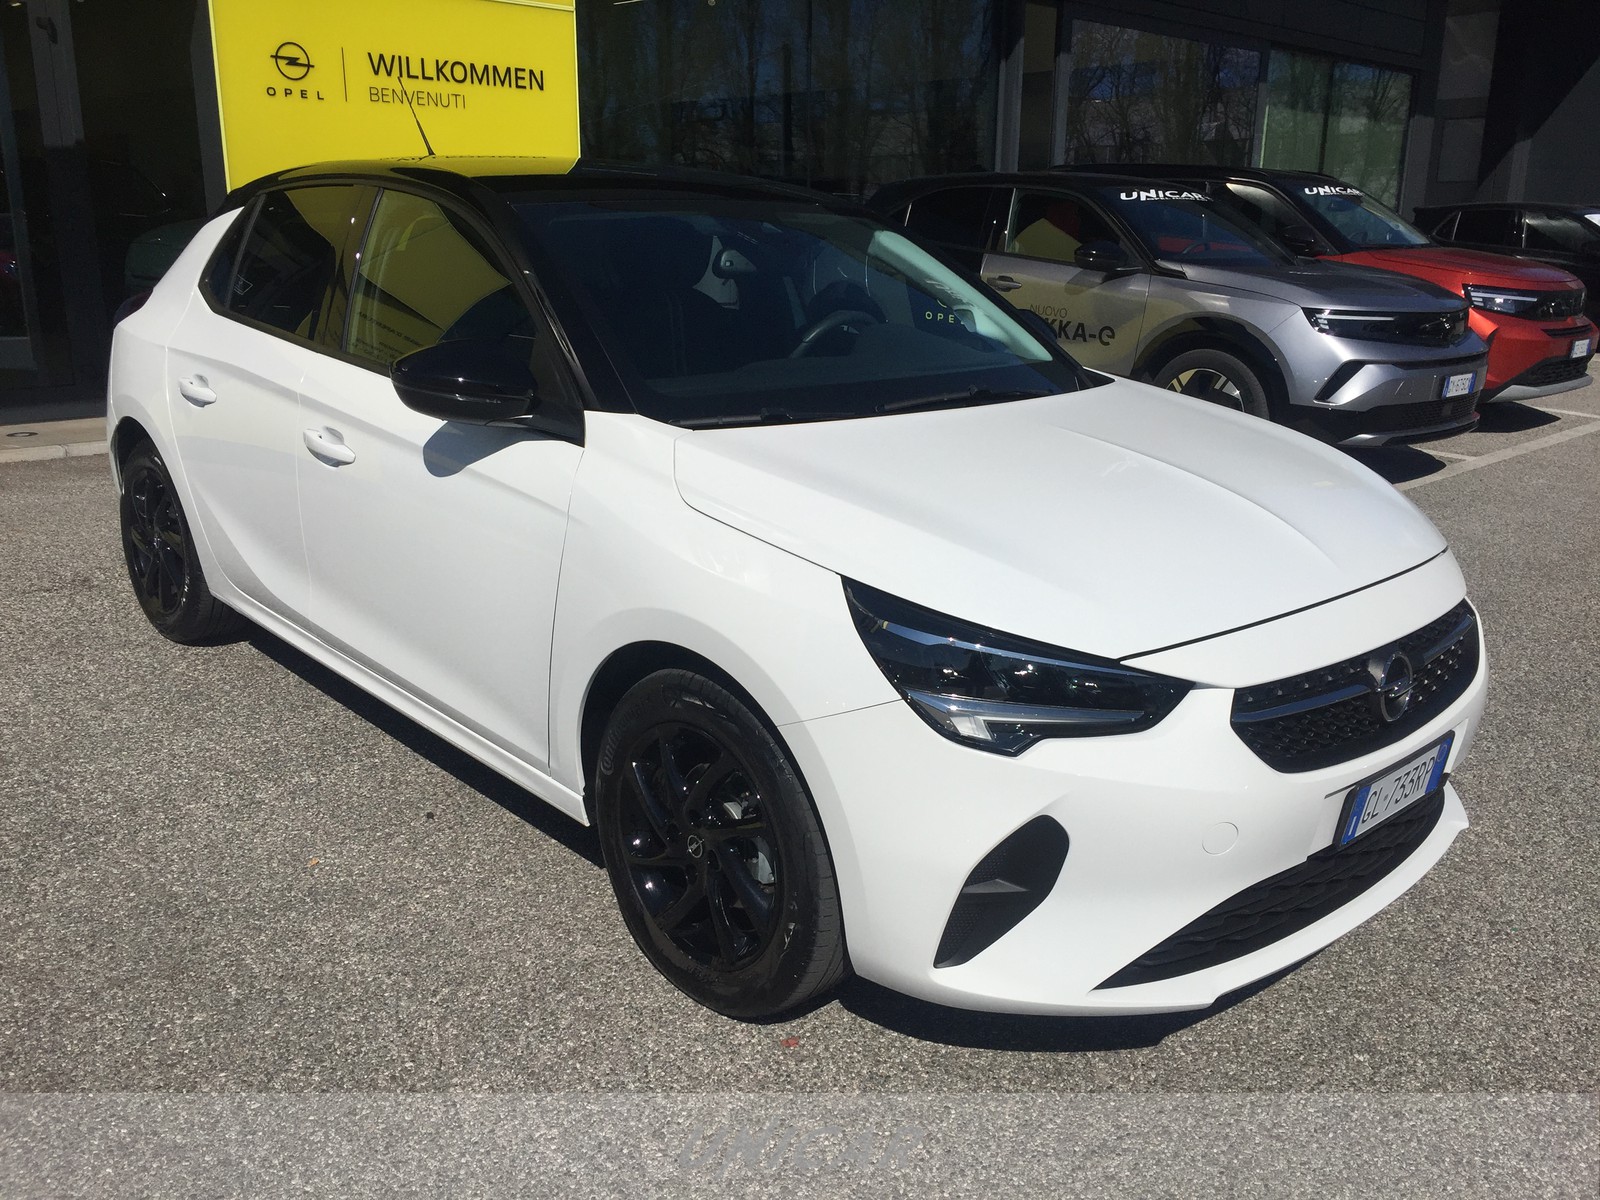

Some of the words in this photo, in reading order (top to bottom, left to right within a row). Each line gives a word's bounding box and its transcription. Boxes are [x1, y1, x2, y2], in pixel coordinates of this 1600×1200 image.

[367, 51, 545, 91] WILLKOMMEN
[266, 86, 325, 101] OPEL
[368, 86, 466, 109] BENVENUTI
[925, 311, 962, 324] OPE
[1029, 304, 1068, 319] NUOVO
